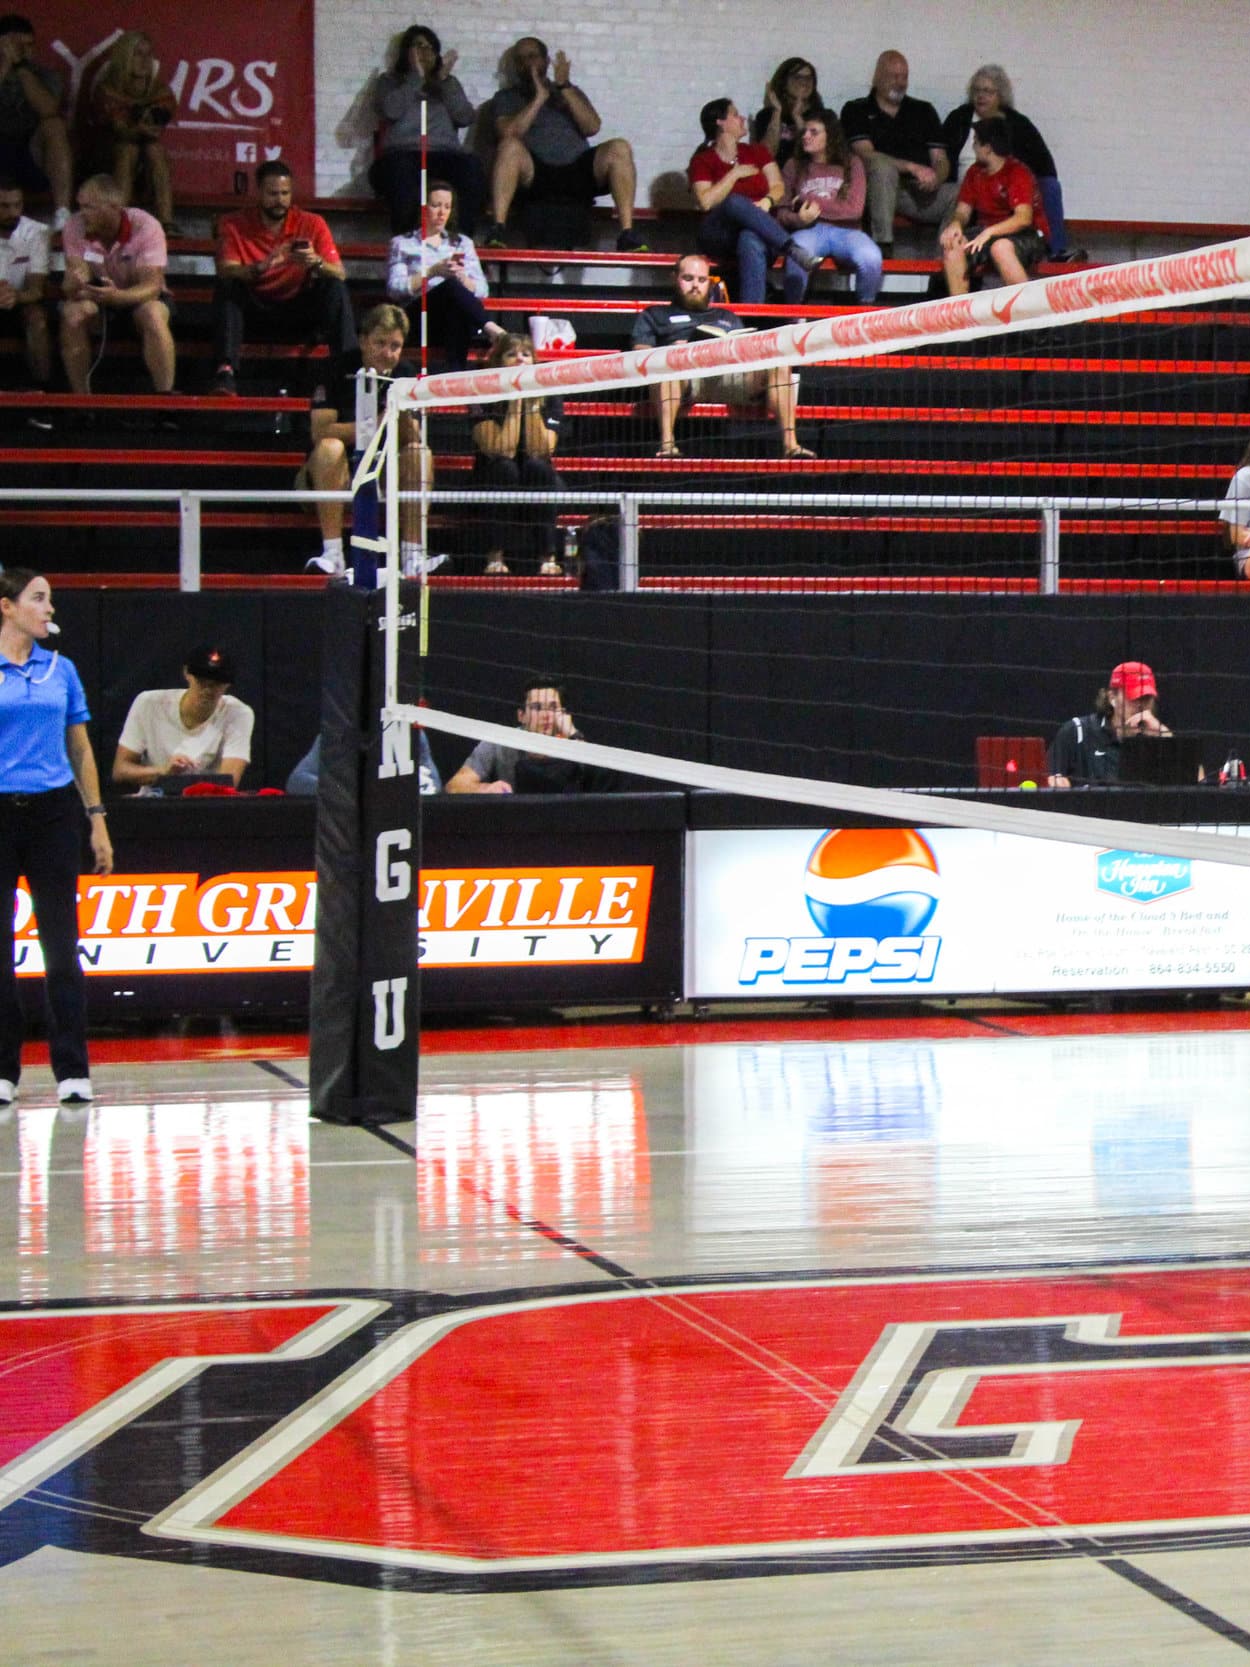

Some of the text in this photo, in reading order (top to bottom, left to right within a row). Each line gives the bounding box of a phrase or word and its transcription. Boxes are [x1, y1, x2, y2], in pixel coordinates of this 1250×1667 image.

[1158, 247, 1244, 294] UNIVERSITY
[738, 936, 941, 985] PEPSI
[1051, 963, 1128, 977] Reservation
